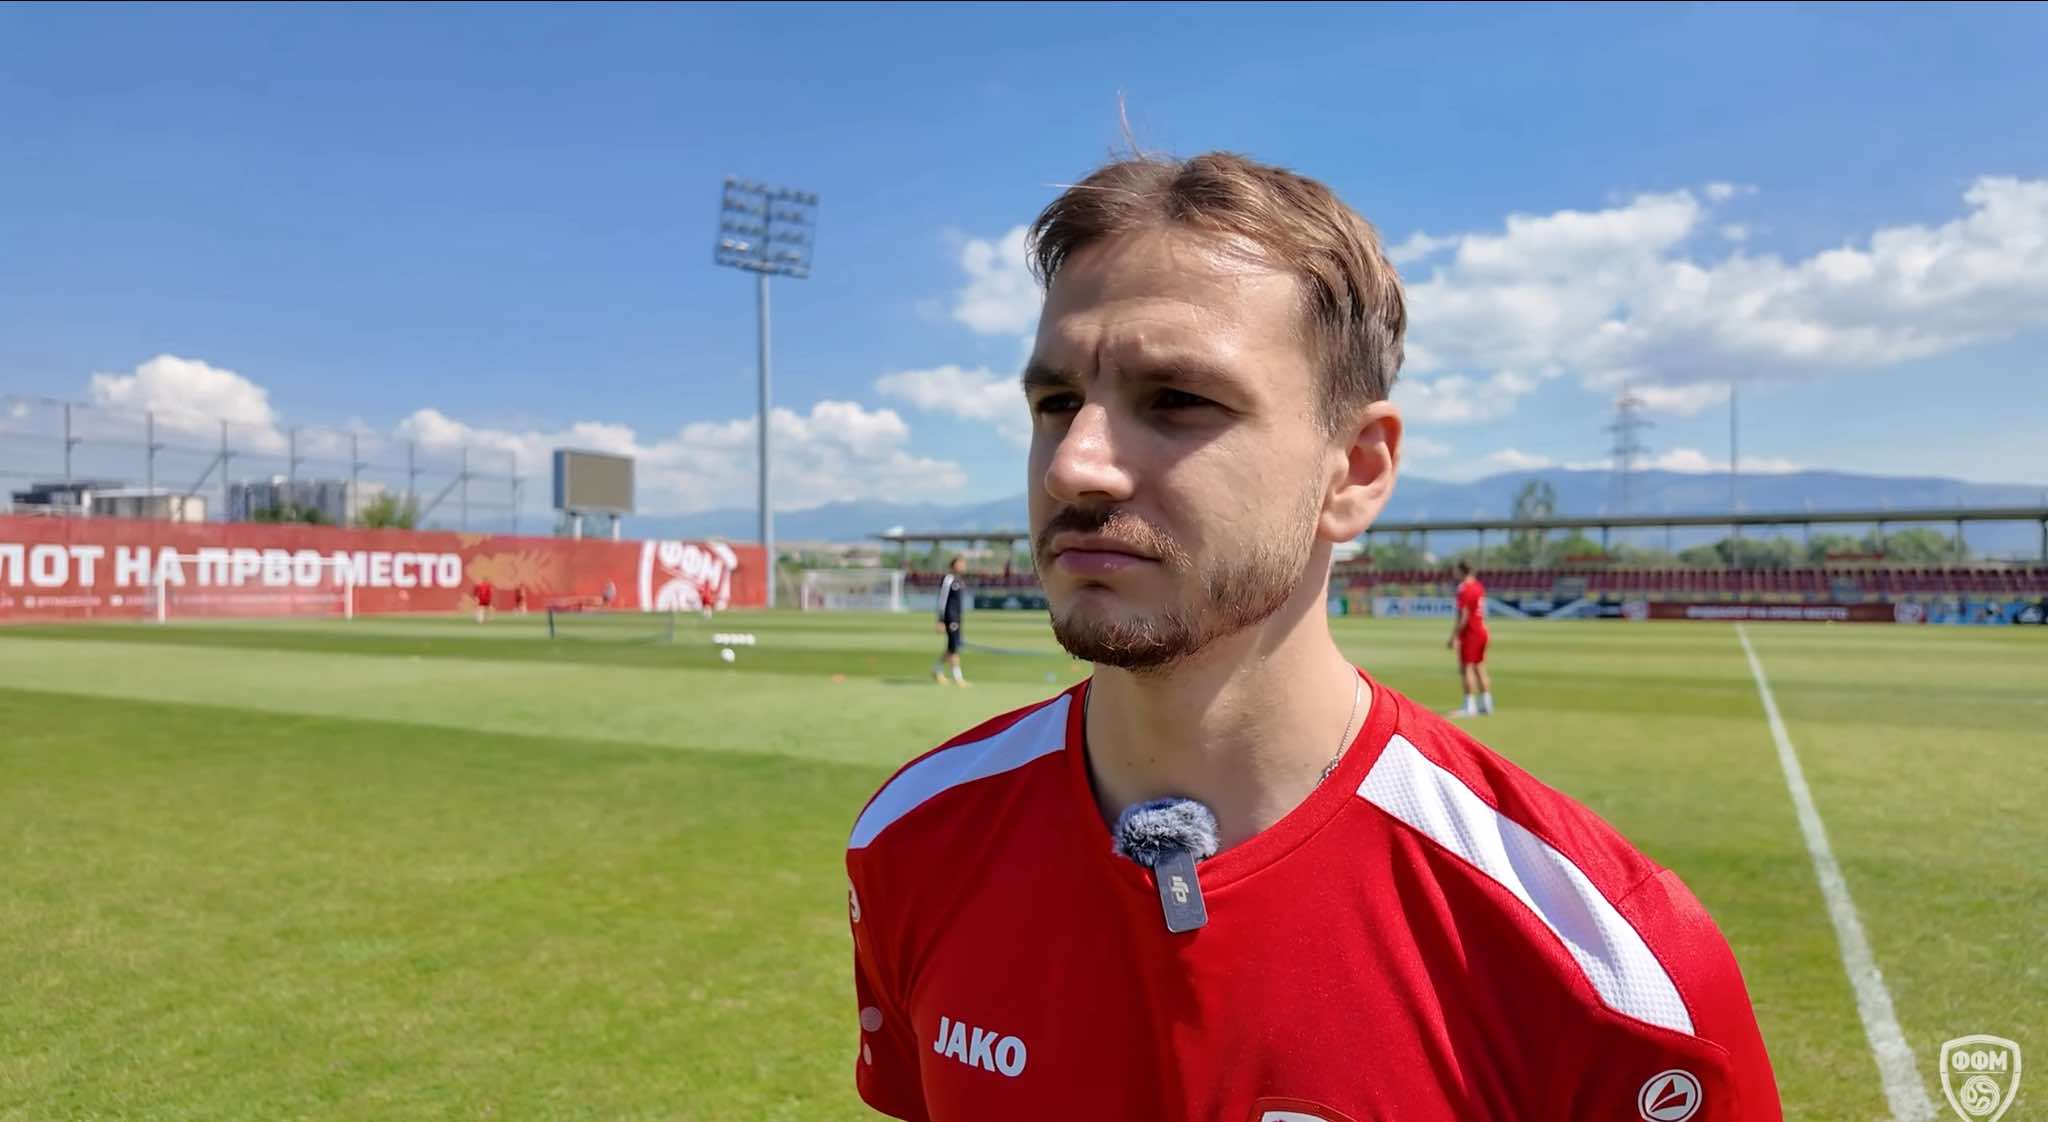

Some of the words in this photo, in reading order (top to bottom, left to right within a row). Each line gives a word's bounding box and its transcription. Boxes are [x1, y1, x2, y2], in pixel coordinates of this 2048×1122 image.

[115, 545, 186, 587] НА
[198, 548, 323, 587] ПРВО
[333, 550, 462, 588] МЕСТО
[934, 1015, 1027, 1077] JAKO
